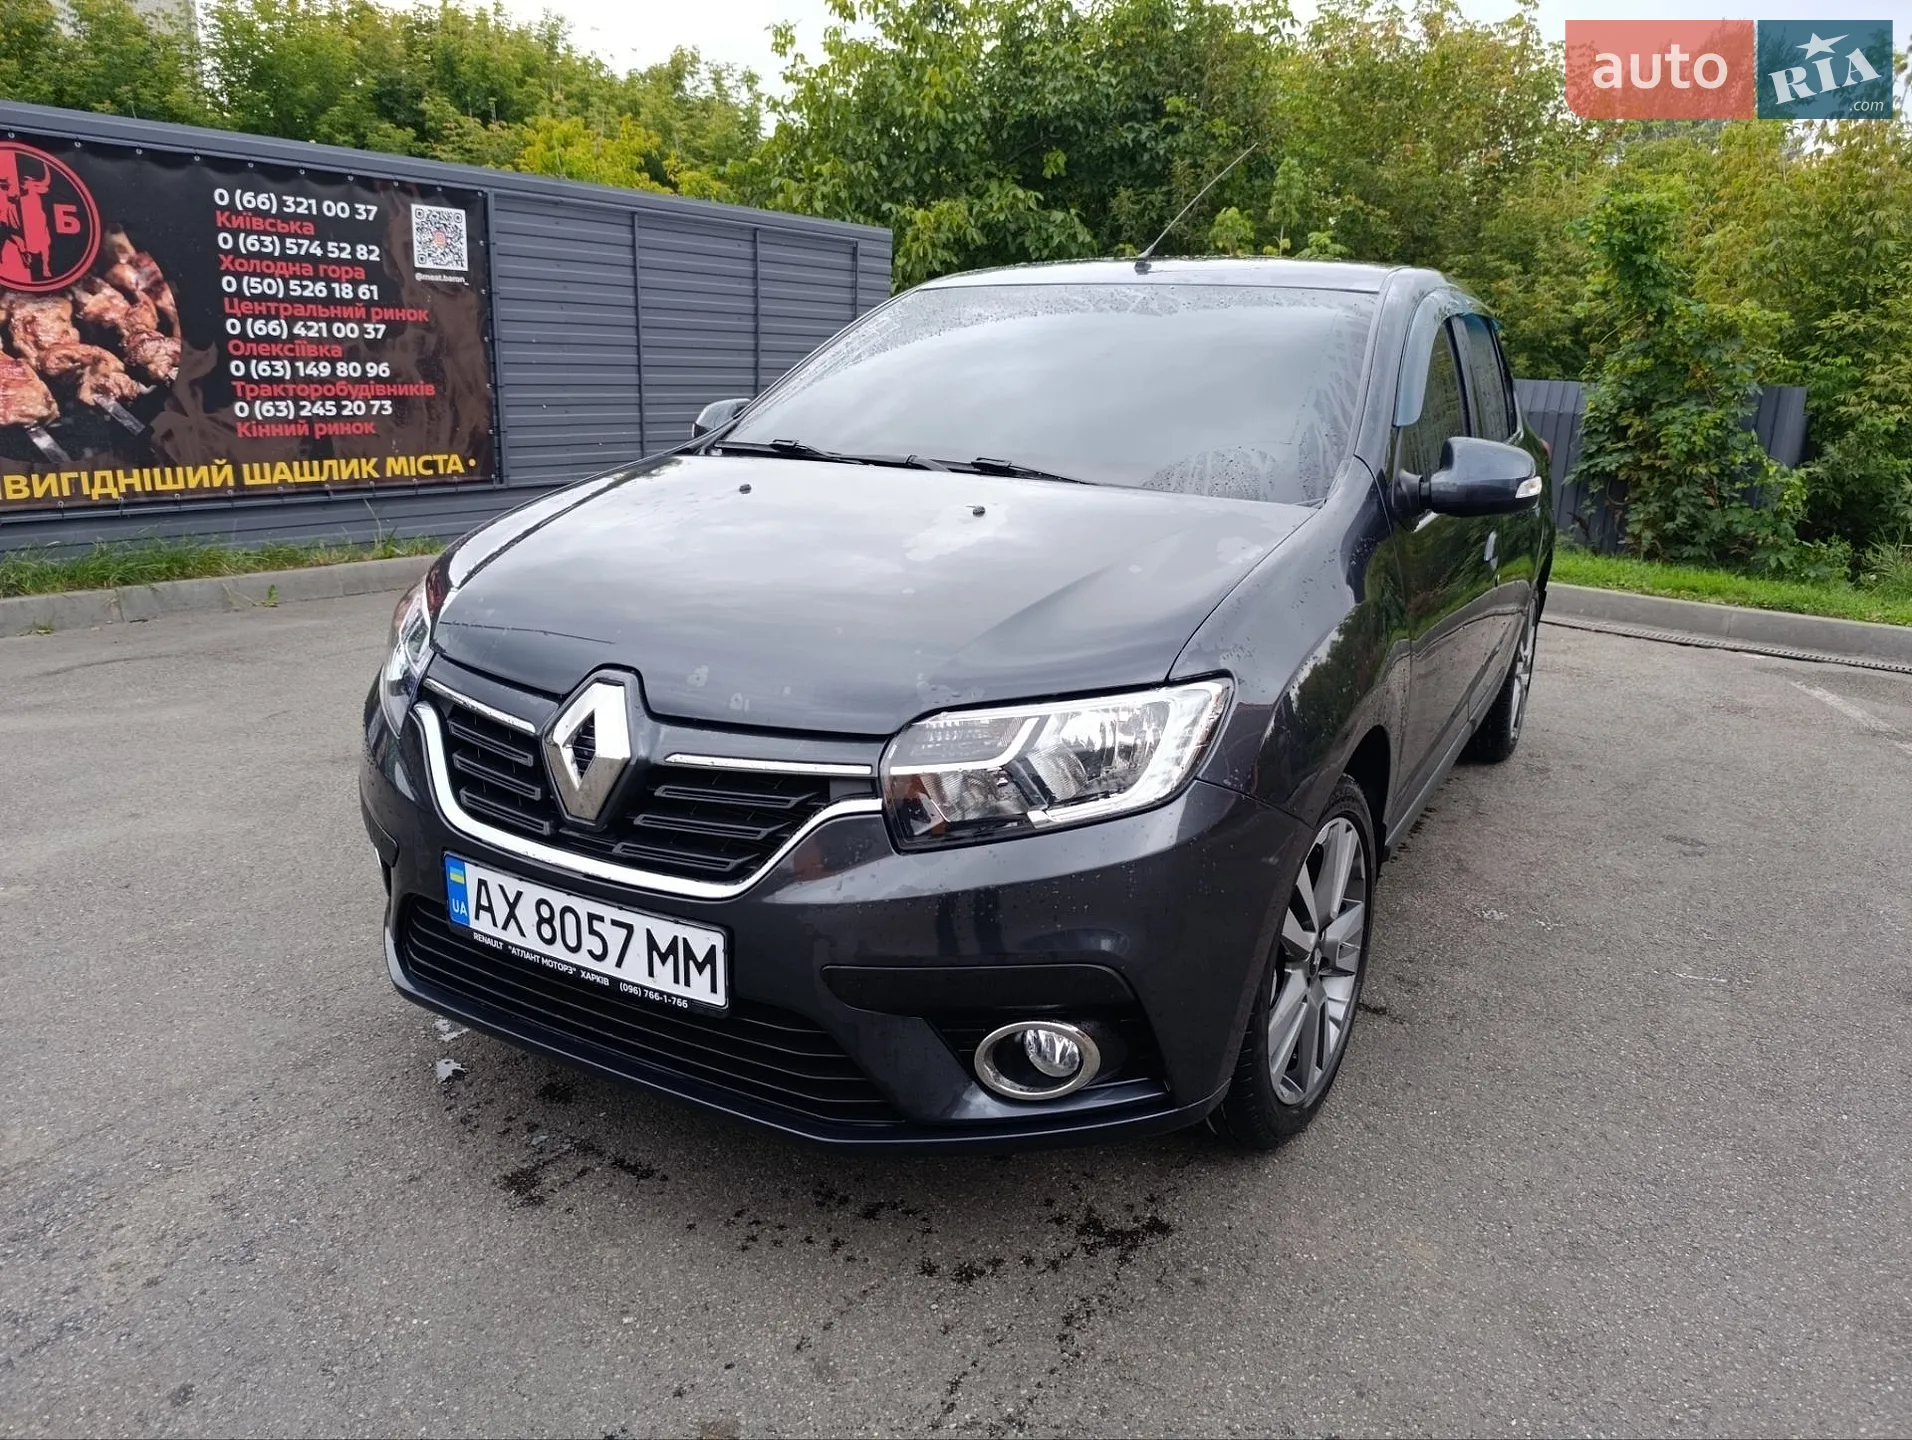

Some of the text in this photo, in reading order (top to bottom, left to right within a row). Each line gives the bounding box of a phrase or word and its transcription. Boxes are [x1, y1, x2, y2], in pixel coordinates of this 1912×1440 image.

[214, 188, 378, 221] 0 (66) 321 00 37
[53, 203, 81, 234] Б
[216, 210, 315, 235] Київська
[218, 232, 380, 261] 0 (63) 574 52 82
[220, 254, 366, 282] Холодна гора
[222, 276, 379, 300] 0 (50) 526 18 61
[224, 297, 429, 323] Центральний ринок
[226, 318, 387, 339] 0 (66) 421 00 37
[228, 340, 343, 358] Олексіївка
[230, 360, 390, 380] 0 (63) 149 80 96
[231, 381, 436, 400] Тракторобудівників
[234, 400, 392, 419] 0 (63) 245 20 73
[236, 419, 376, 439] Кінний ринок
[0, 454, 465, 500] ВИГІДНІШИЙ ШАШЛИК МІСТА
[452, 898, 468, 917] UA
[474, 878, 718, 995] AX 8057 MM
[473, 931, 504, 950] RENAULT
[580, 970, 610, 986] ХАРКІВ
[619, 981, 642, 997] (096)
[643, 988, 689, 1009] 766-1-766
